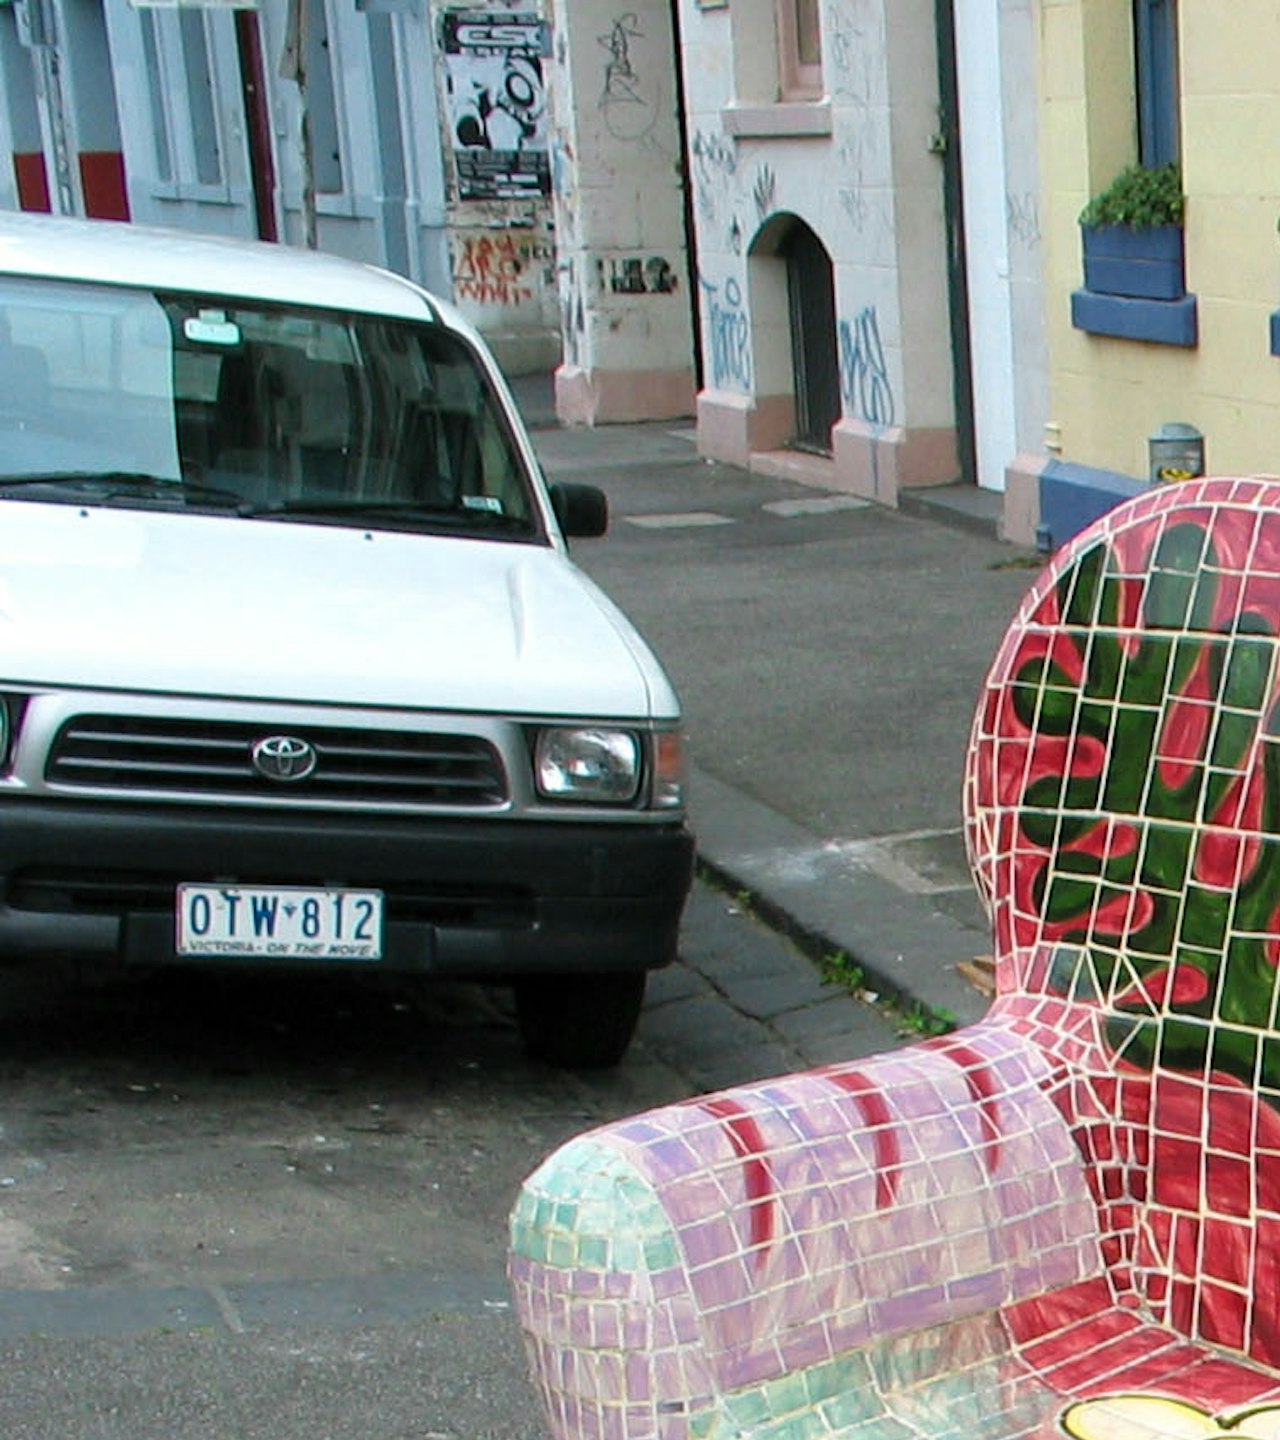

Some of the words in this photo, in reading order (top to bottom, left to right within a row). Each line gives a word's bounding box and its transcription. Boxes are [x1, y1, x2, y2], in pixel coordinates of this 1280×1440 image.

[190, 892, 279, 937] OTW
[302, 894, 373, 941] 812
[295, 942, 326, 955] THE
